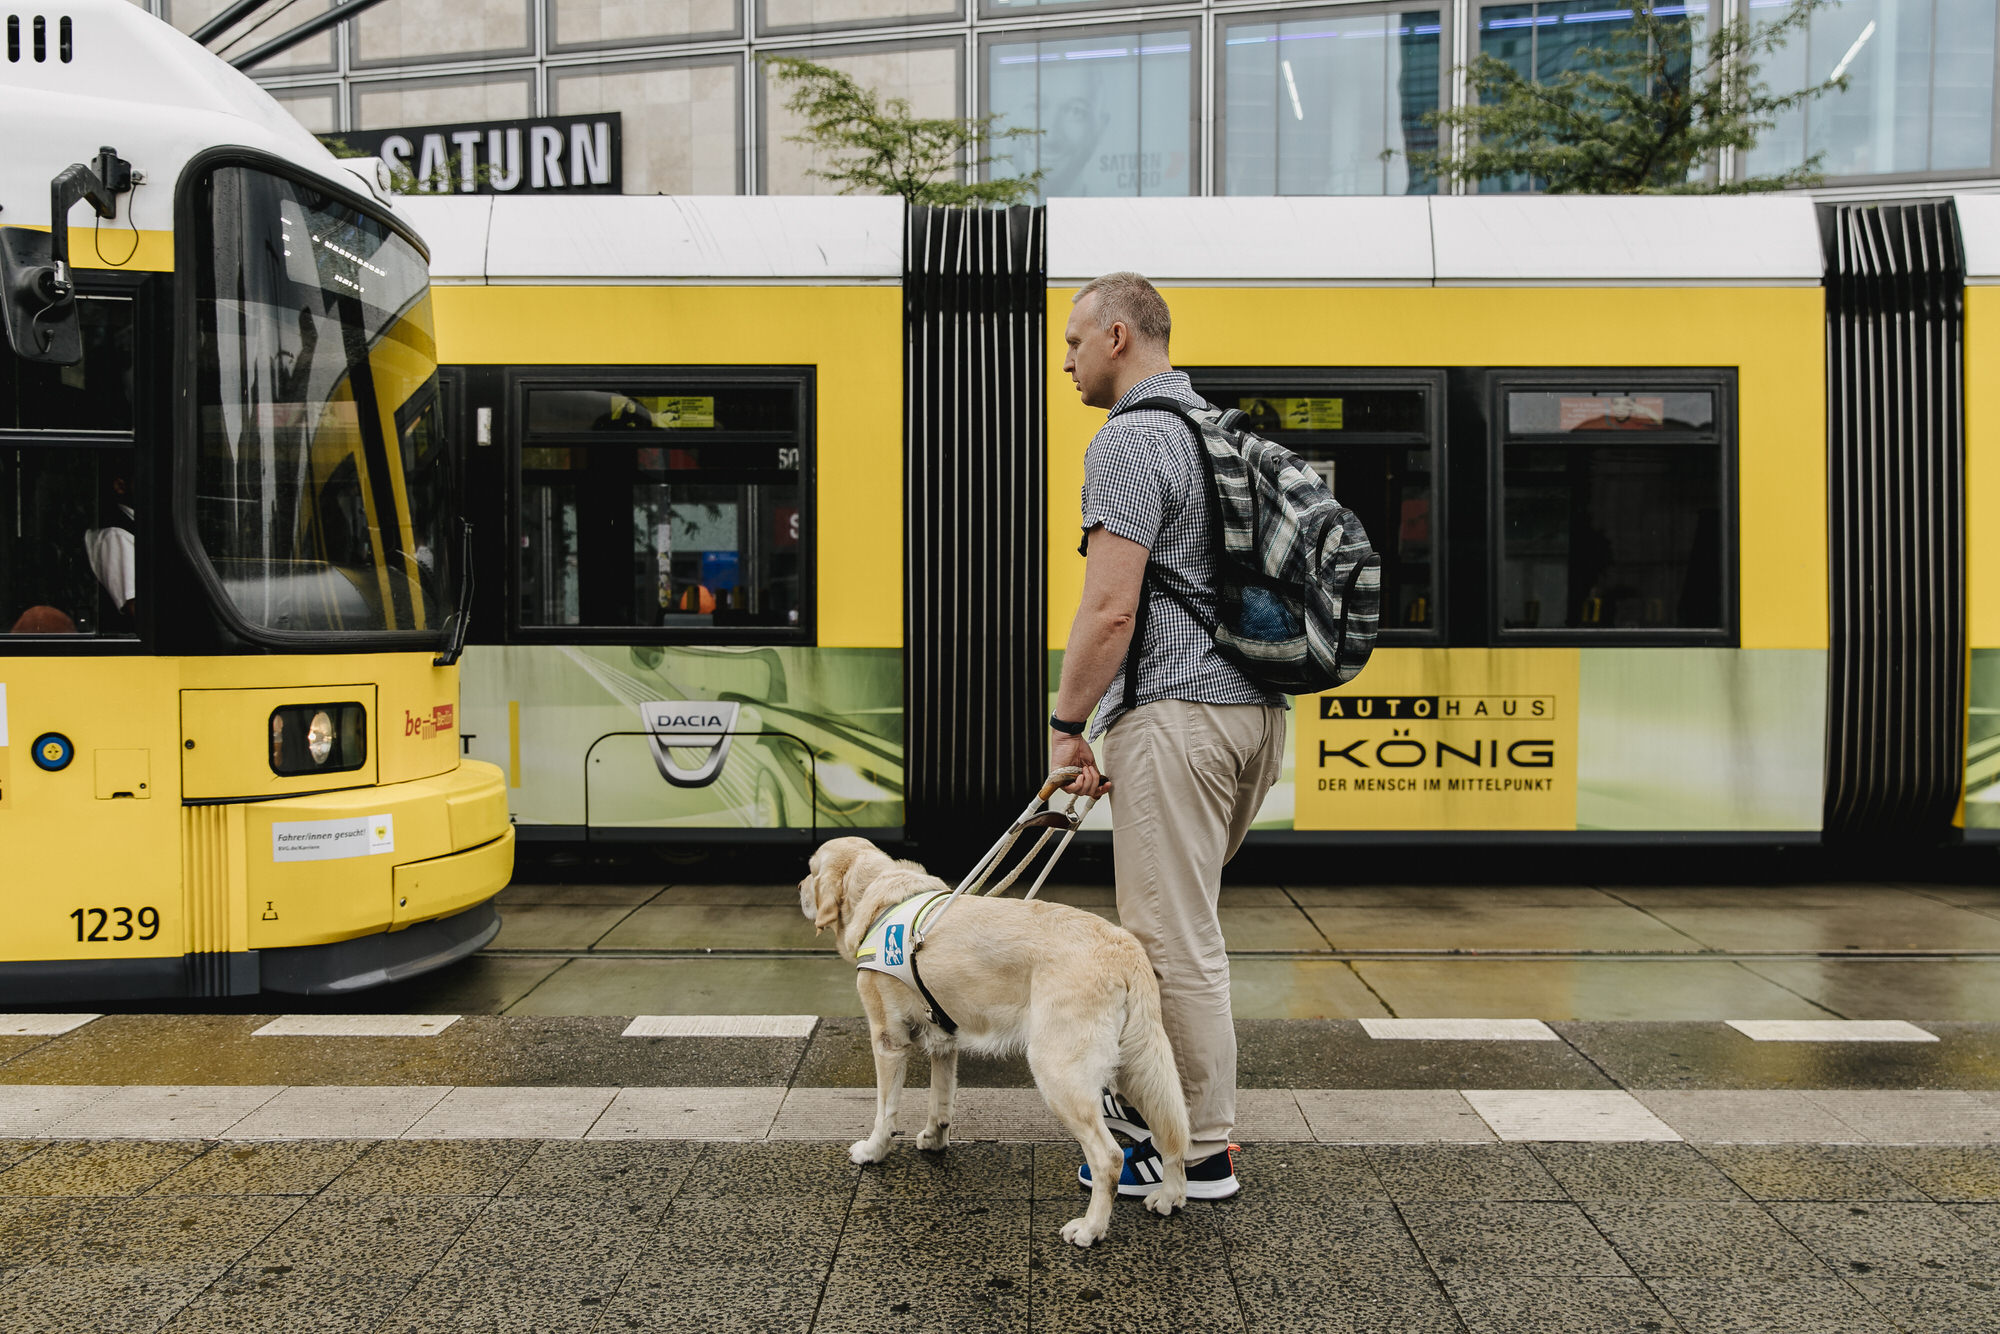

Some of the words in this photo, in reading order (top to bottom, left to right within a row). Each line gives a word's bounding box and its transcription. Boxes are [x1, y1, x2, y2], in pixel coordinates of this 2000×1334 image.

[381, 121, 611, 193] SATURN
[1099, 153, 1161, 173] SATURN
[1327, 699, 1546, 718] AUTOHAUS
[657, 715, 722, 727] DACIA
[1319, 728, 1555, 768] KÖNIG
[1318, 778, 1347, 791] DER
[1354, 778, 1417, 791] MENSCH
[1423, 778, 1441, 791] IM
[1448, 778, 1553, 791] MITTELPUNKT
[277, 831, 332, 842] Fahrer/innen
[334, 828, 367, 841] gesucht!
[70, 906, 160, 942] 1239
